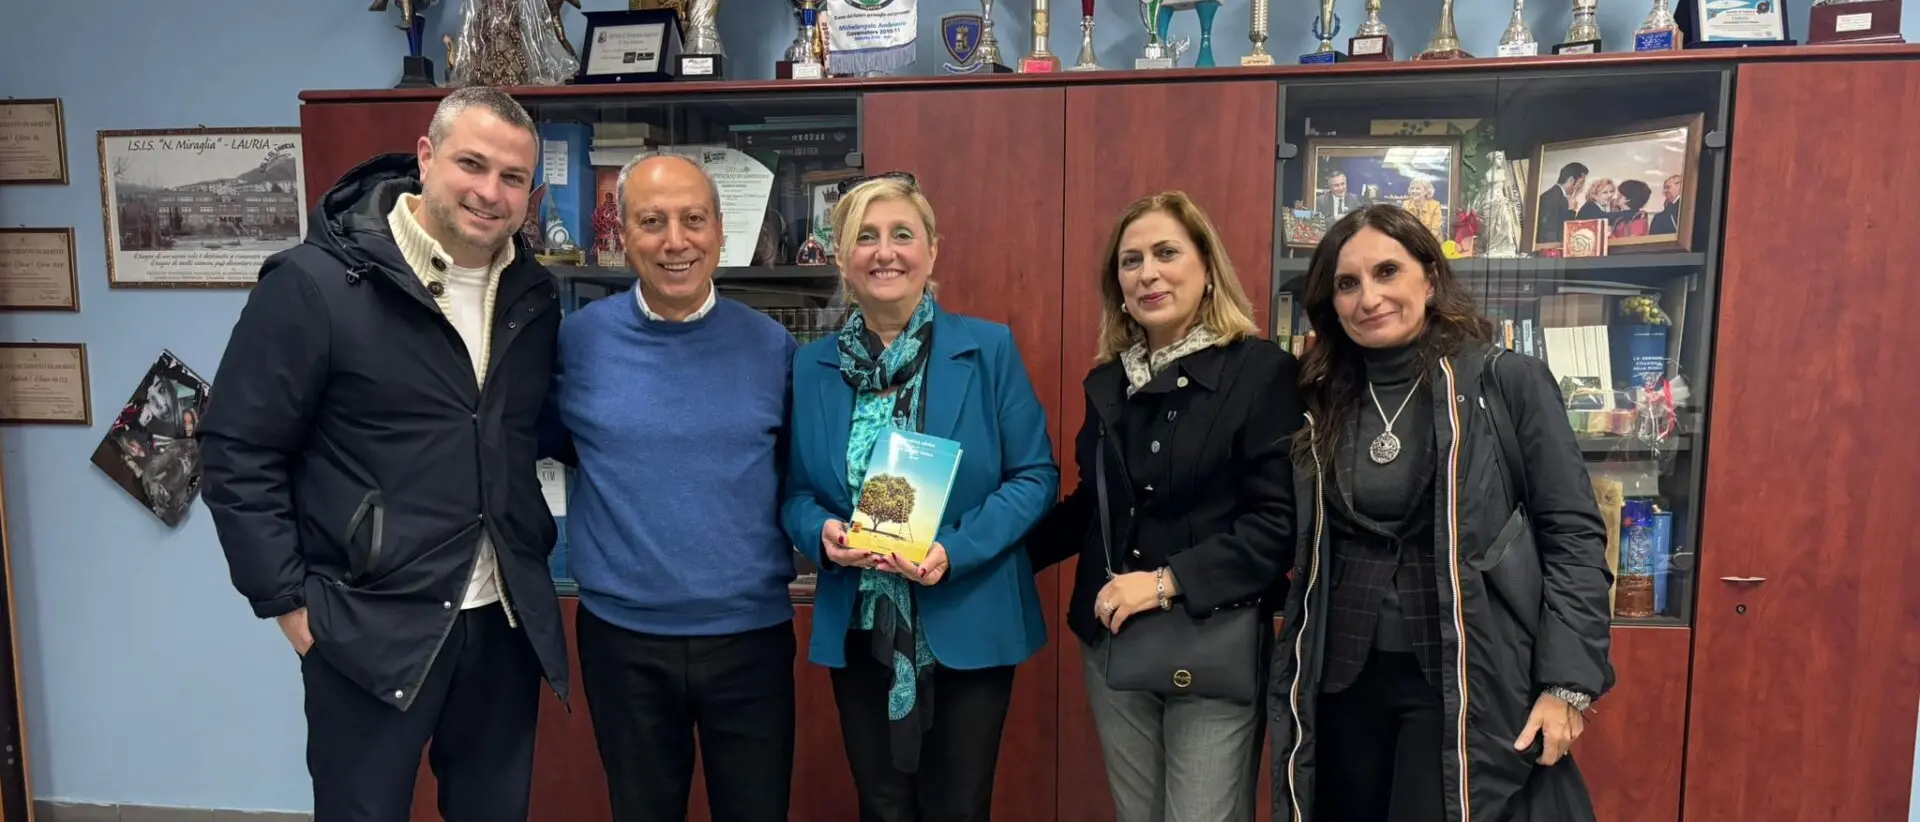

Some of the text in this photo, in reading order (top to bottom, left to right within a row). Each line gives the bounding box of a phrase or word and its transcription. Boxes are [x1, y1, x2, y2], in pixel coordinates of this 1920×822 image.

[839, 22, 876, 31] Michelangelo
[127, 140, 155, 151] I.S.I.S.
[231, 138, 270, 150] LAURIA
